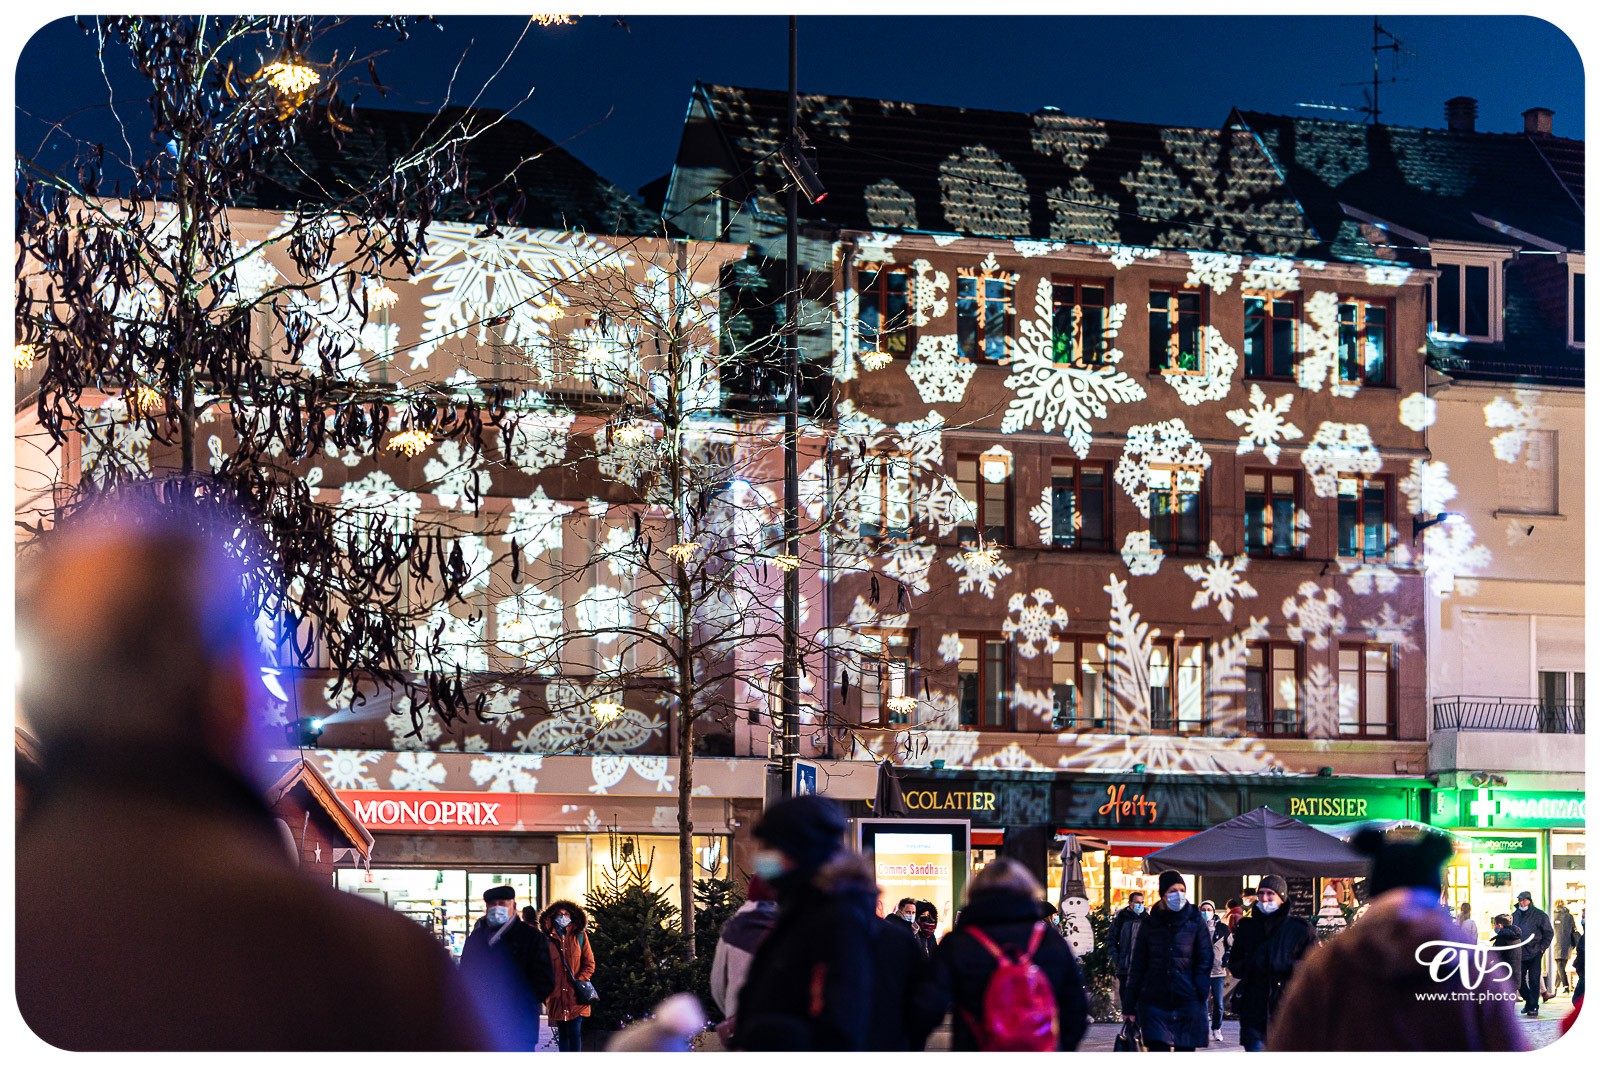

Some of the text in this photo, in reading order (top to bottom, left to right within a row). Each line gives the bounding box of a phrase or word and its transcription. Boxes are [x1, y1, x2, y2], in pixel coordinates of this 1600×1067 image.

[866, 791, 996, 811] COLATIER
[1098, 784, 1157, 824] Heitz
[1290, 797, 1368, 817] PATISSIER
[1500, 798, 1585, 819] PHARMA
[353, 799, 500, 826] MONOPRIX
[909, 863, 949, 876] Sandhaas
